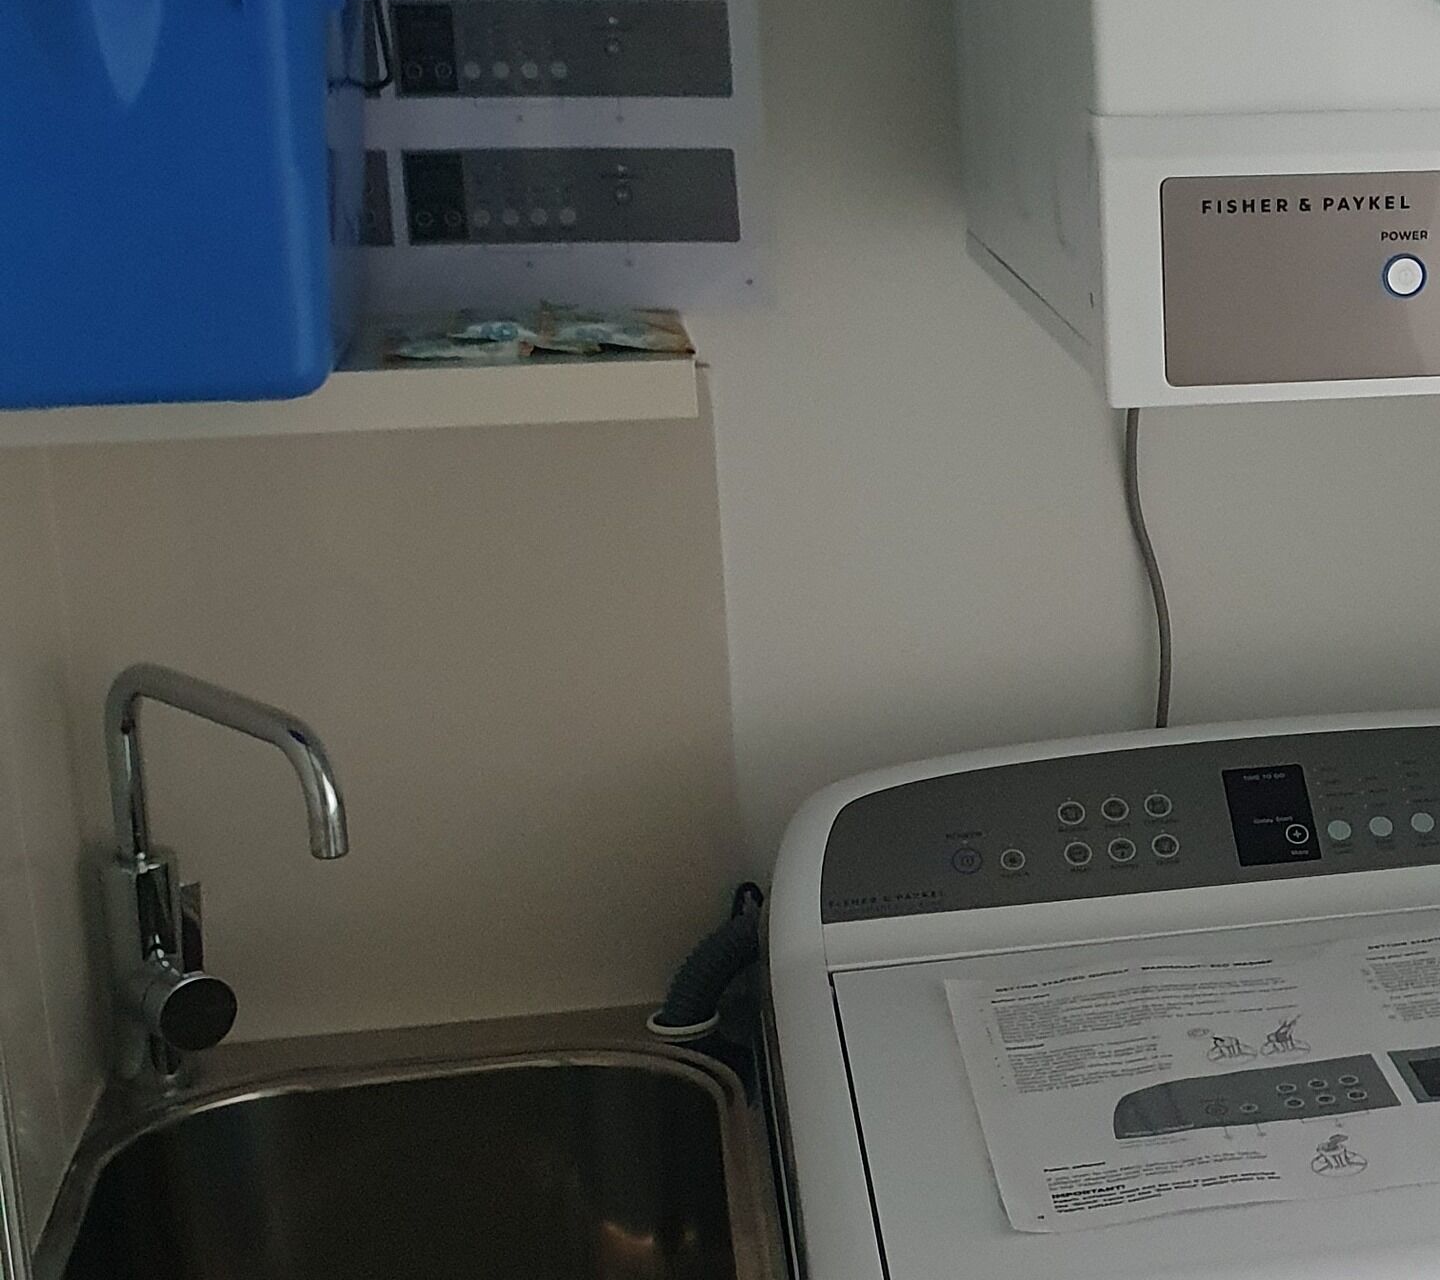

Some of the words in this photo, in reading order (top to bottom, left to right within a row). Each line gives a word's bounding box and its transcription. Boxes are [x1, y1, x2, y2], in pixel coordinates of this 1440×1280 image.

[1201, 198, 1289, 214] FISHER
[1299, 197, 1312, 212] &
[1322, 195, 1411, 212] PAYKEL
[1380, 230, 1429, 242] POWER
